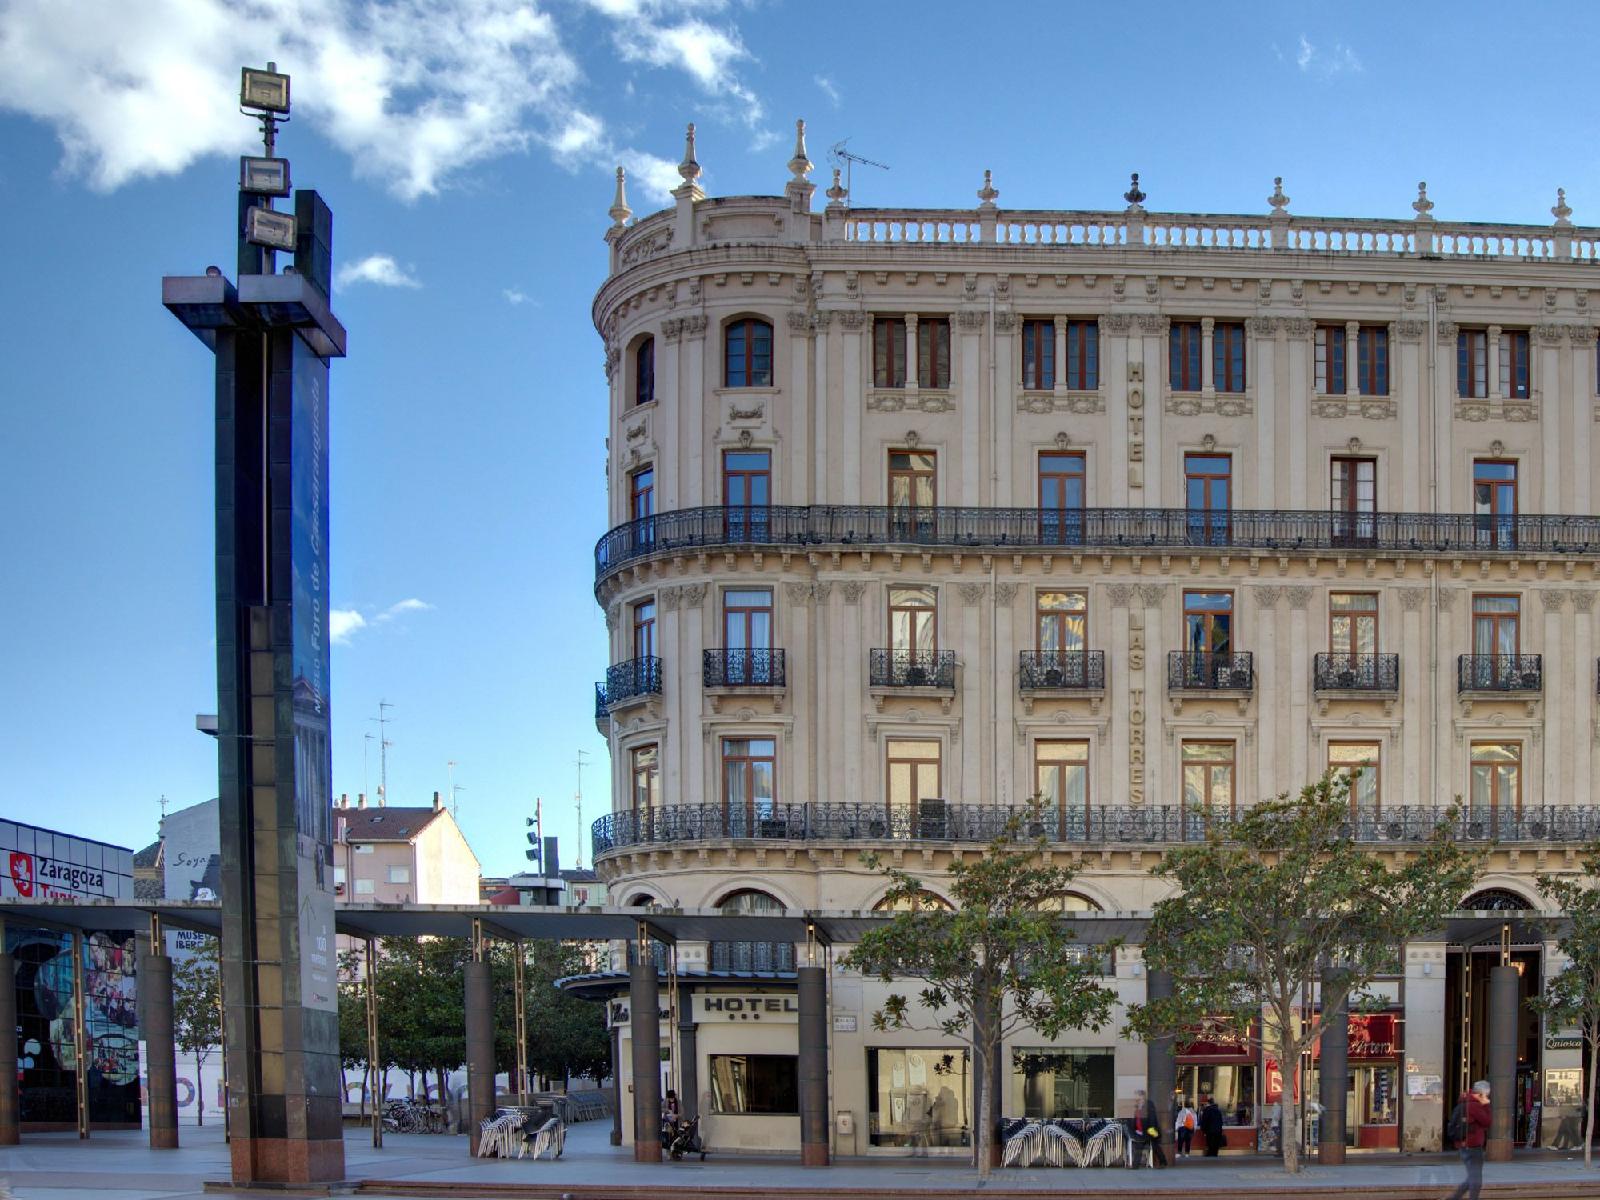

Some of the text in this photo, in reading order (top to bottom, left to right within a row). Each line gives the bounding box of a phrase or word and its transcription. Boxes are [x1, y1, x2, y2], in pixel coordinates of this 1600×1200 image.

[1127, 361, 1143, 489] HOTEL
[311, 562, 320, 592] de
[311, 599, 321, 651] Foro
[1129, 613, 1145, 809] LAS TORRES
[40, 858, 103, 889] Zaragoza
[704, 998, 799, 1012] HOTEL
